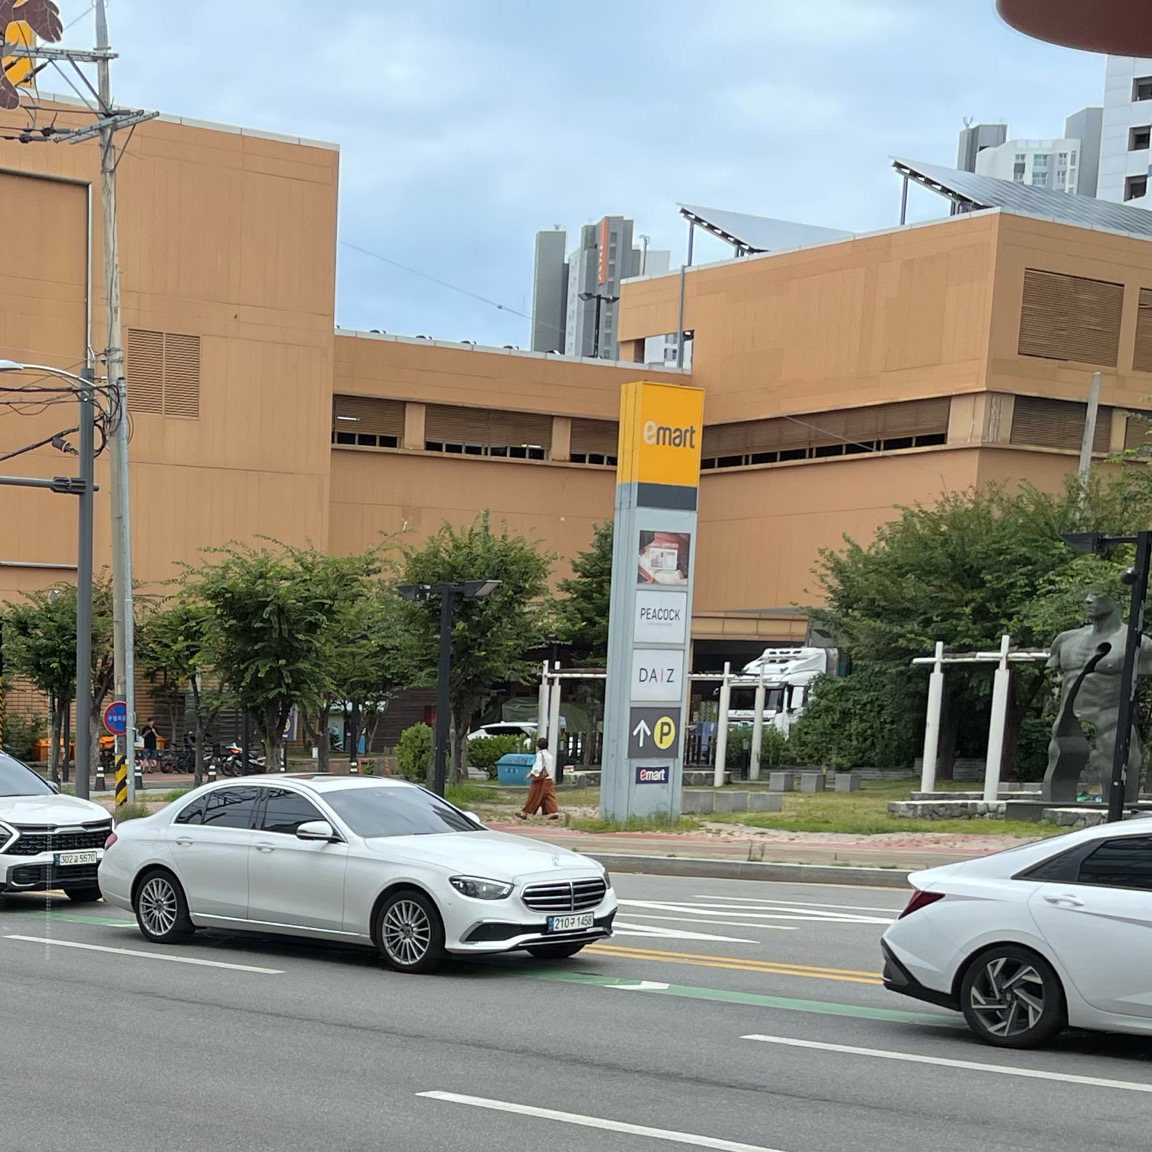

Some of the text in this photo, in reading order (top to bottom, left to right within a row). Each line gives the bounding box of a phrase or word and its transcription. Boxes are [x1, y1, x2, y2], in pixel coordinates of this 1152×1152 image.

[643, 420, 696, 449] emart
[640, 607, 681, 621] PEACOCK
[659, 722, 672, 745] P
[639, 769, 666, 782] emart
